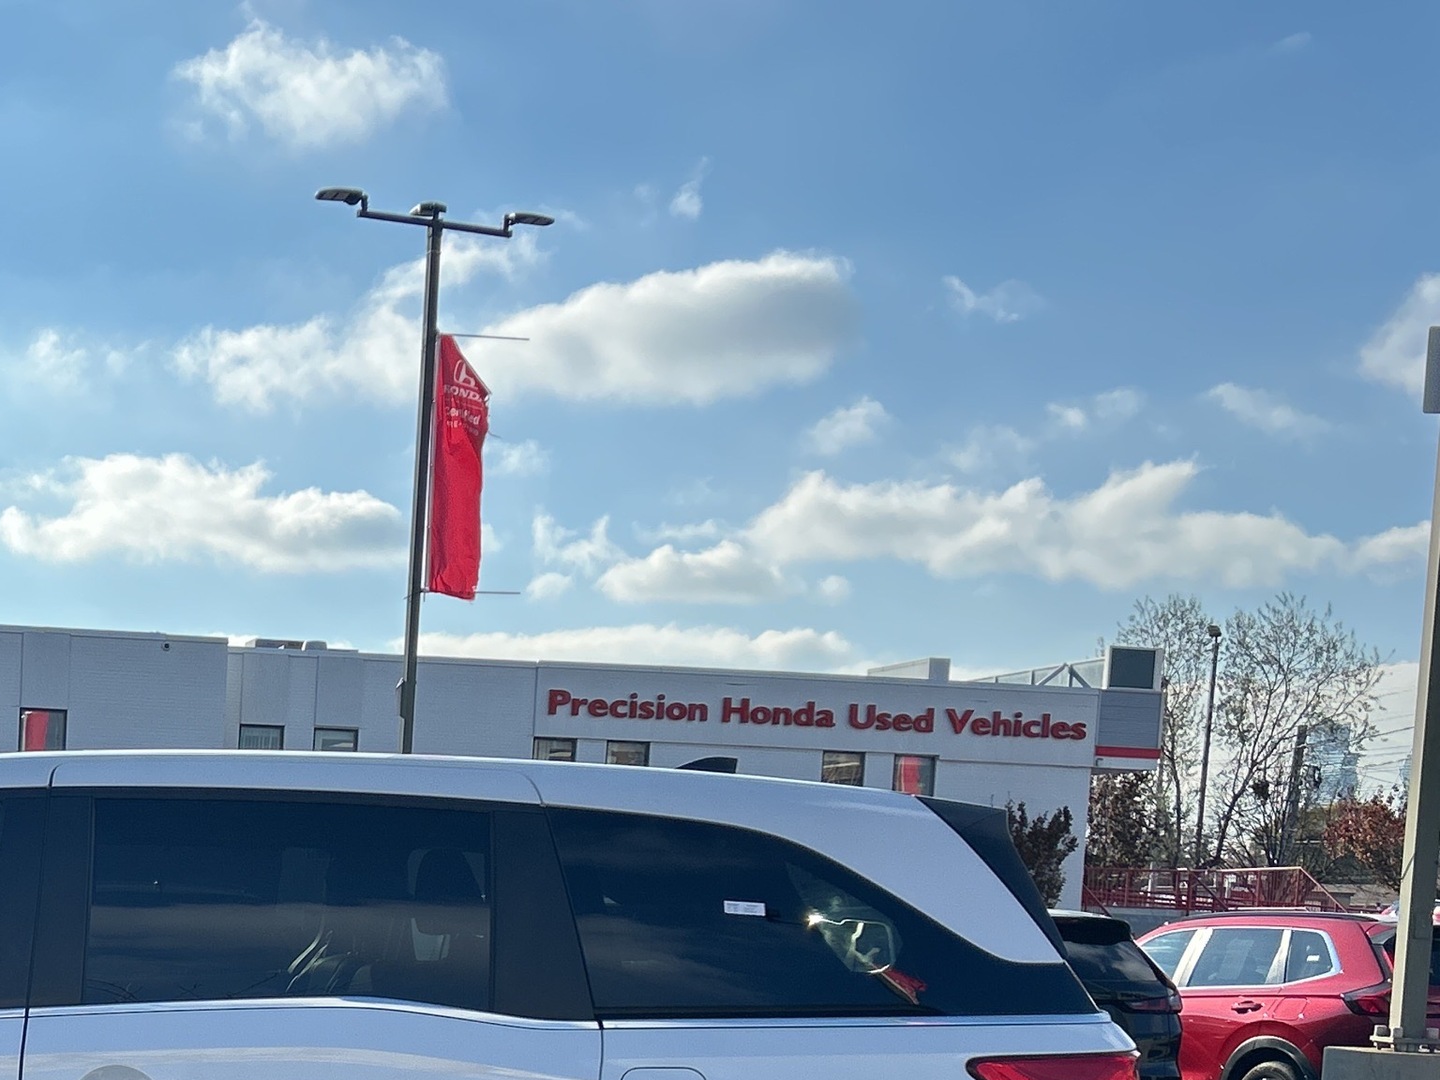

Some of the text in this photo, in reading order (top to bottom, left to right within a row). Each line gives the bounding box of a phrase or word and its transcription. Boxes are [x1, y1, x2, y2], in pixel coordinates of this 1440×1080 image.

[547, 688, 1088, 741] Precision Honda Used Vehicles
